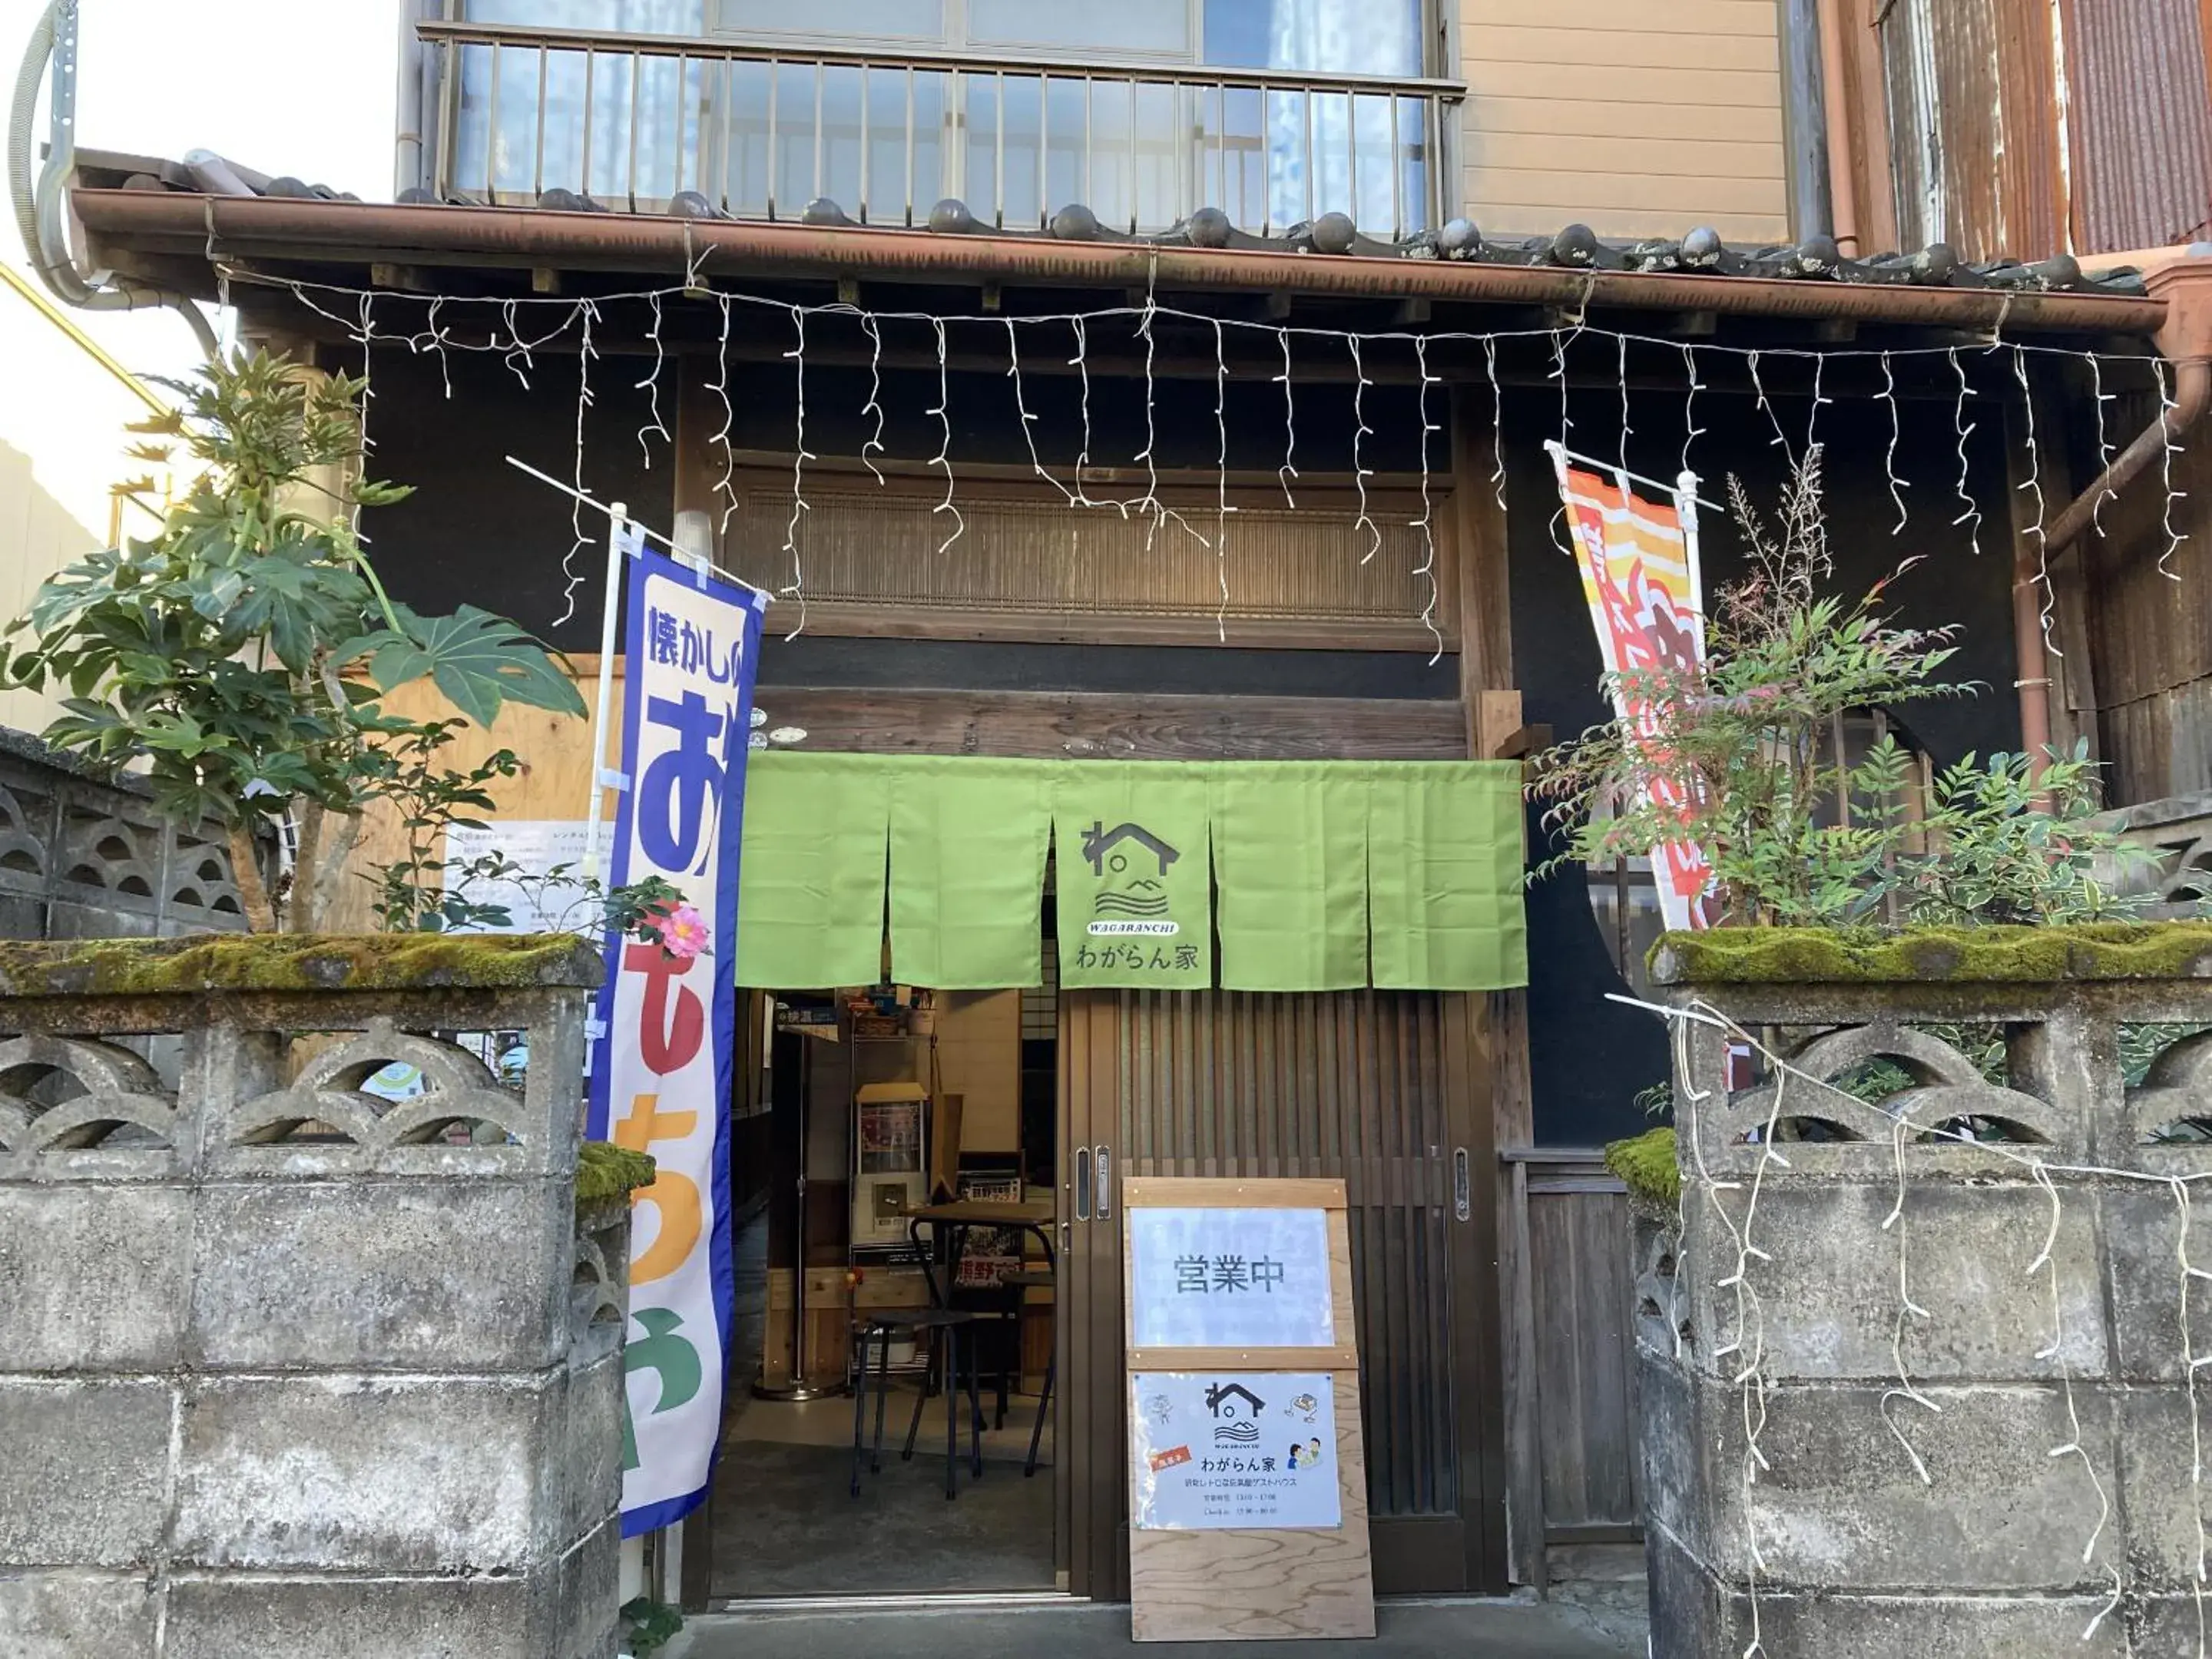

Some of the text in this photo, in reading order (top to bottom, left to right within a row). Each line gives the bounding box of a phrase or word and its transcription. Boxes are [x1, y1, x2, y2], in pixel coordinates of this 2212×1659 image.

[1090, 924, 1176, 933] WAGARANCHI
[1076, 944, 1199, 970] わがらん家
[1174, 1253, 1285, 1293] 営業中
[1200, 1457, 1277, 1473] わがらん家
